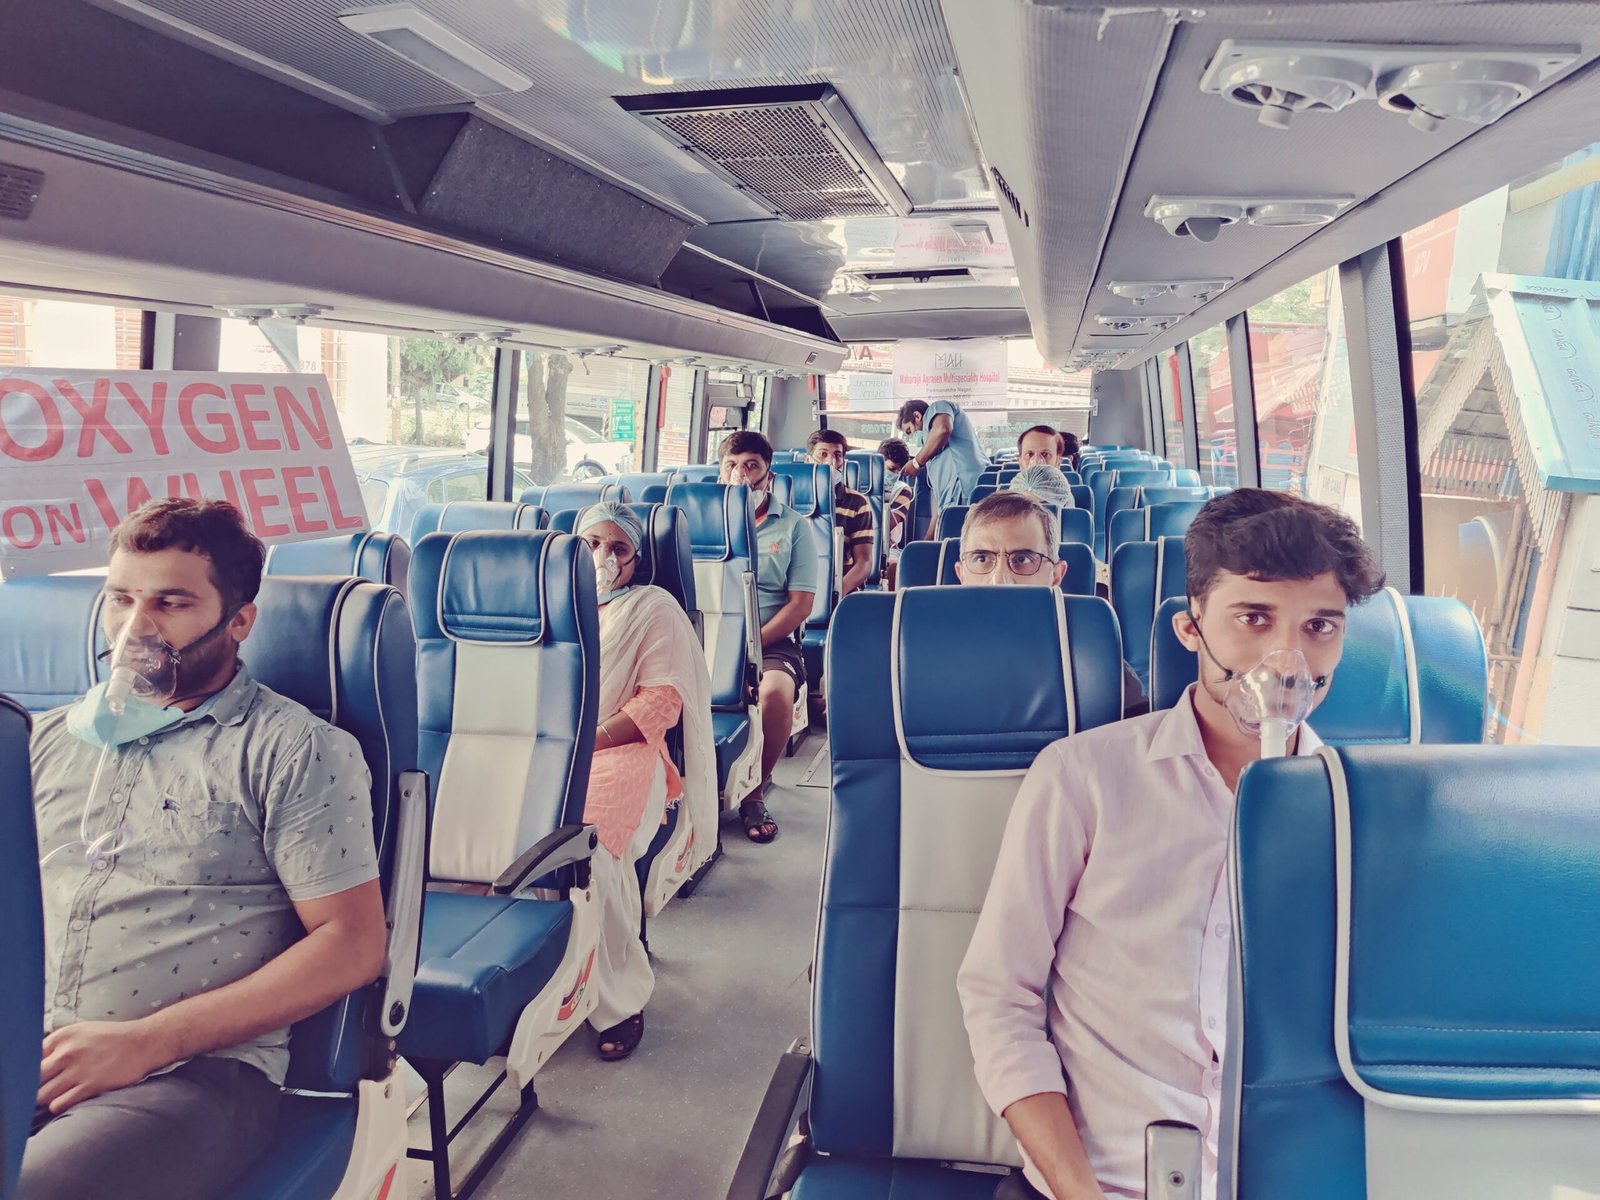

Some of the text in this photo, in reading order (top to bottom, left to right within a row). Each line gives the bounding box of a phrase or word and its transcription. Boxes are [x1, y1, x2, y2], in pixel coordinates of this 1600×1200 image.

[980, 370, 1000, 384] Hospital
[0, 377, 334, 462] OXYGEN
[2, 502, 86, 549] ON
